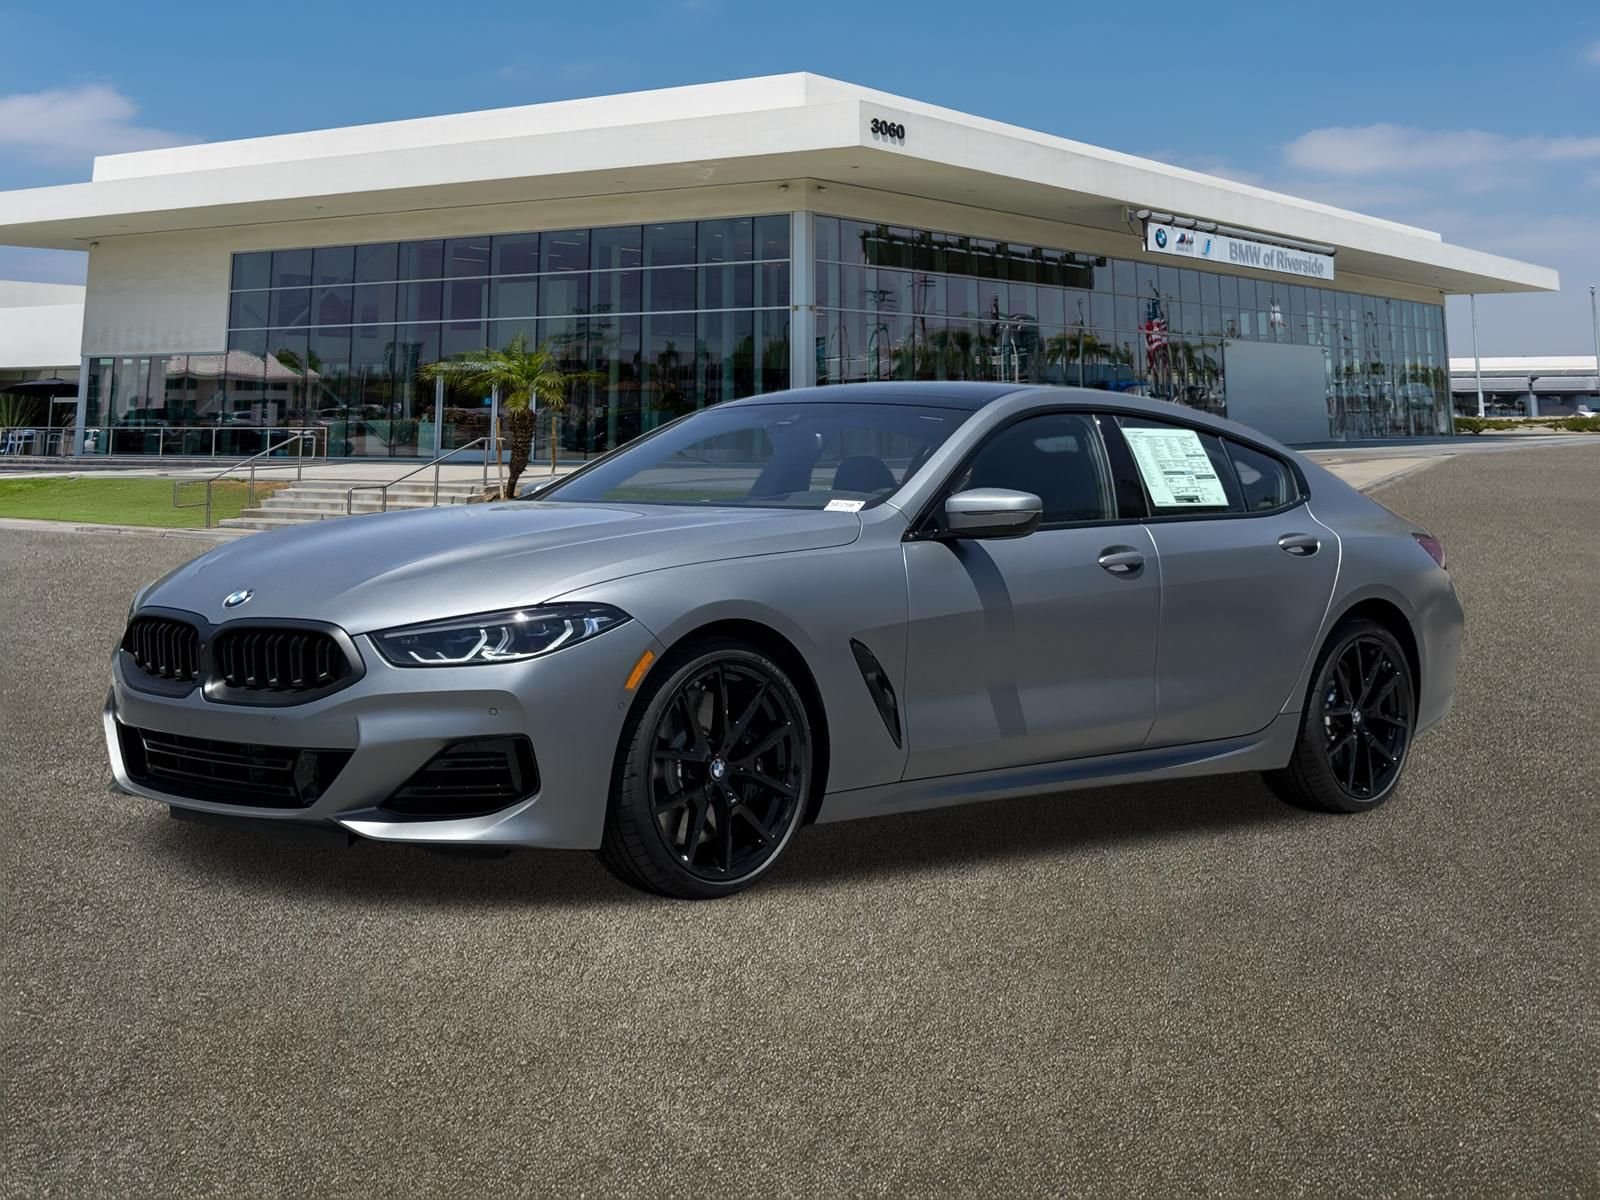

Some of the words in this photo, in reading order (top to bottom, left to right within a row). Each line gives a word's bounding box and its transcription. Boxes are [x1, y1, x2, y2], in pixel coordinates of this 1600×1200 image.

[871, 118, 905, 139] 3060
[1229, 241, 1261, 264] BMW
[1263, 249, 1275, 268] of
[1277, 251, 1324, 275] Riverside
